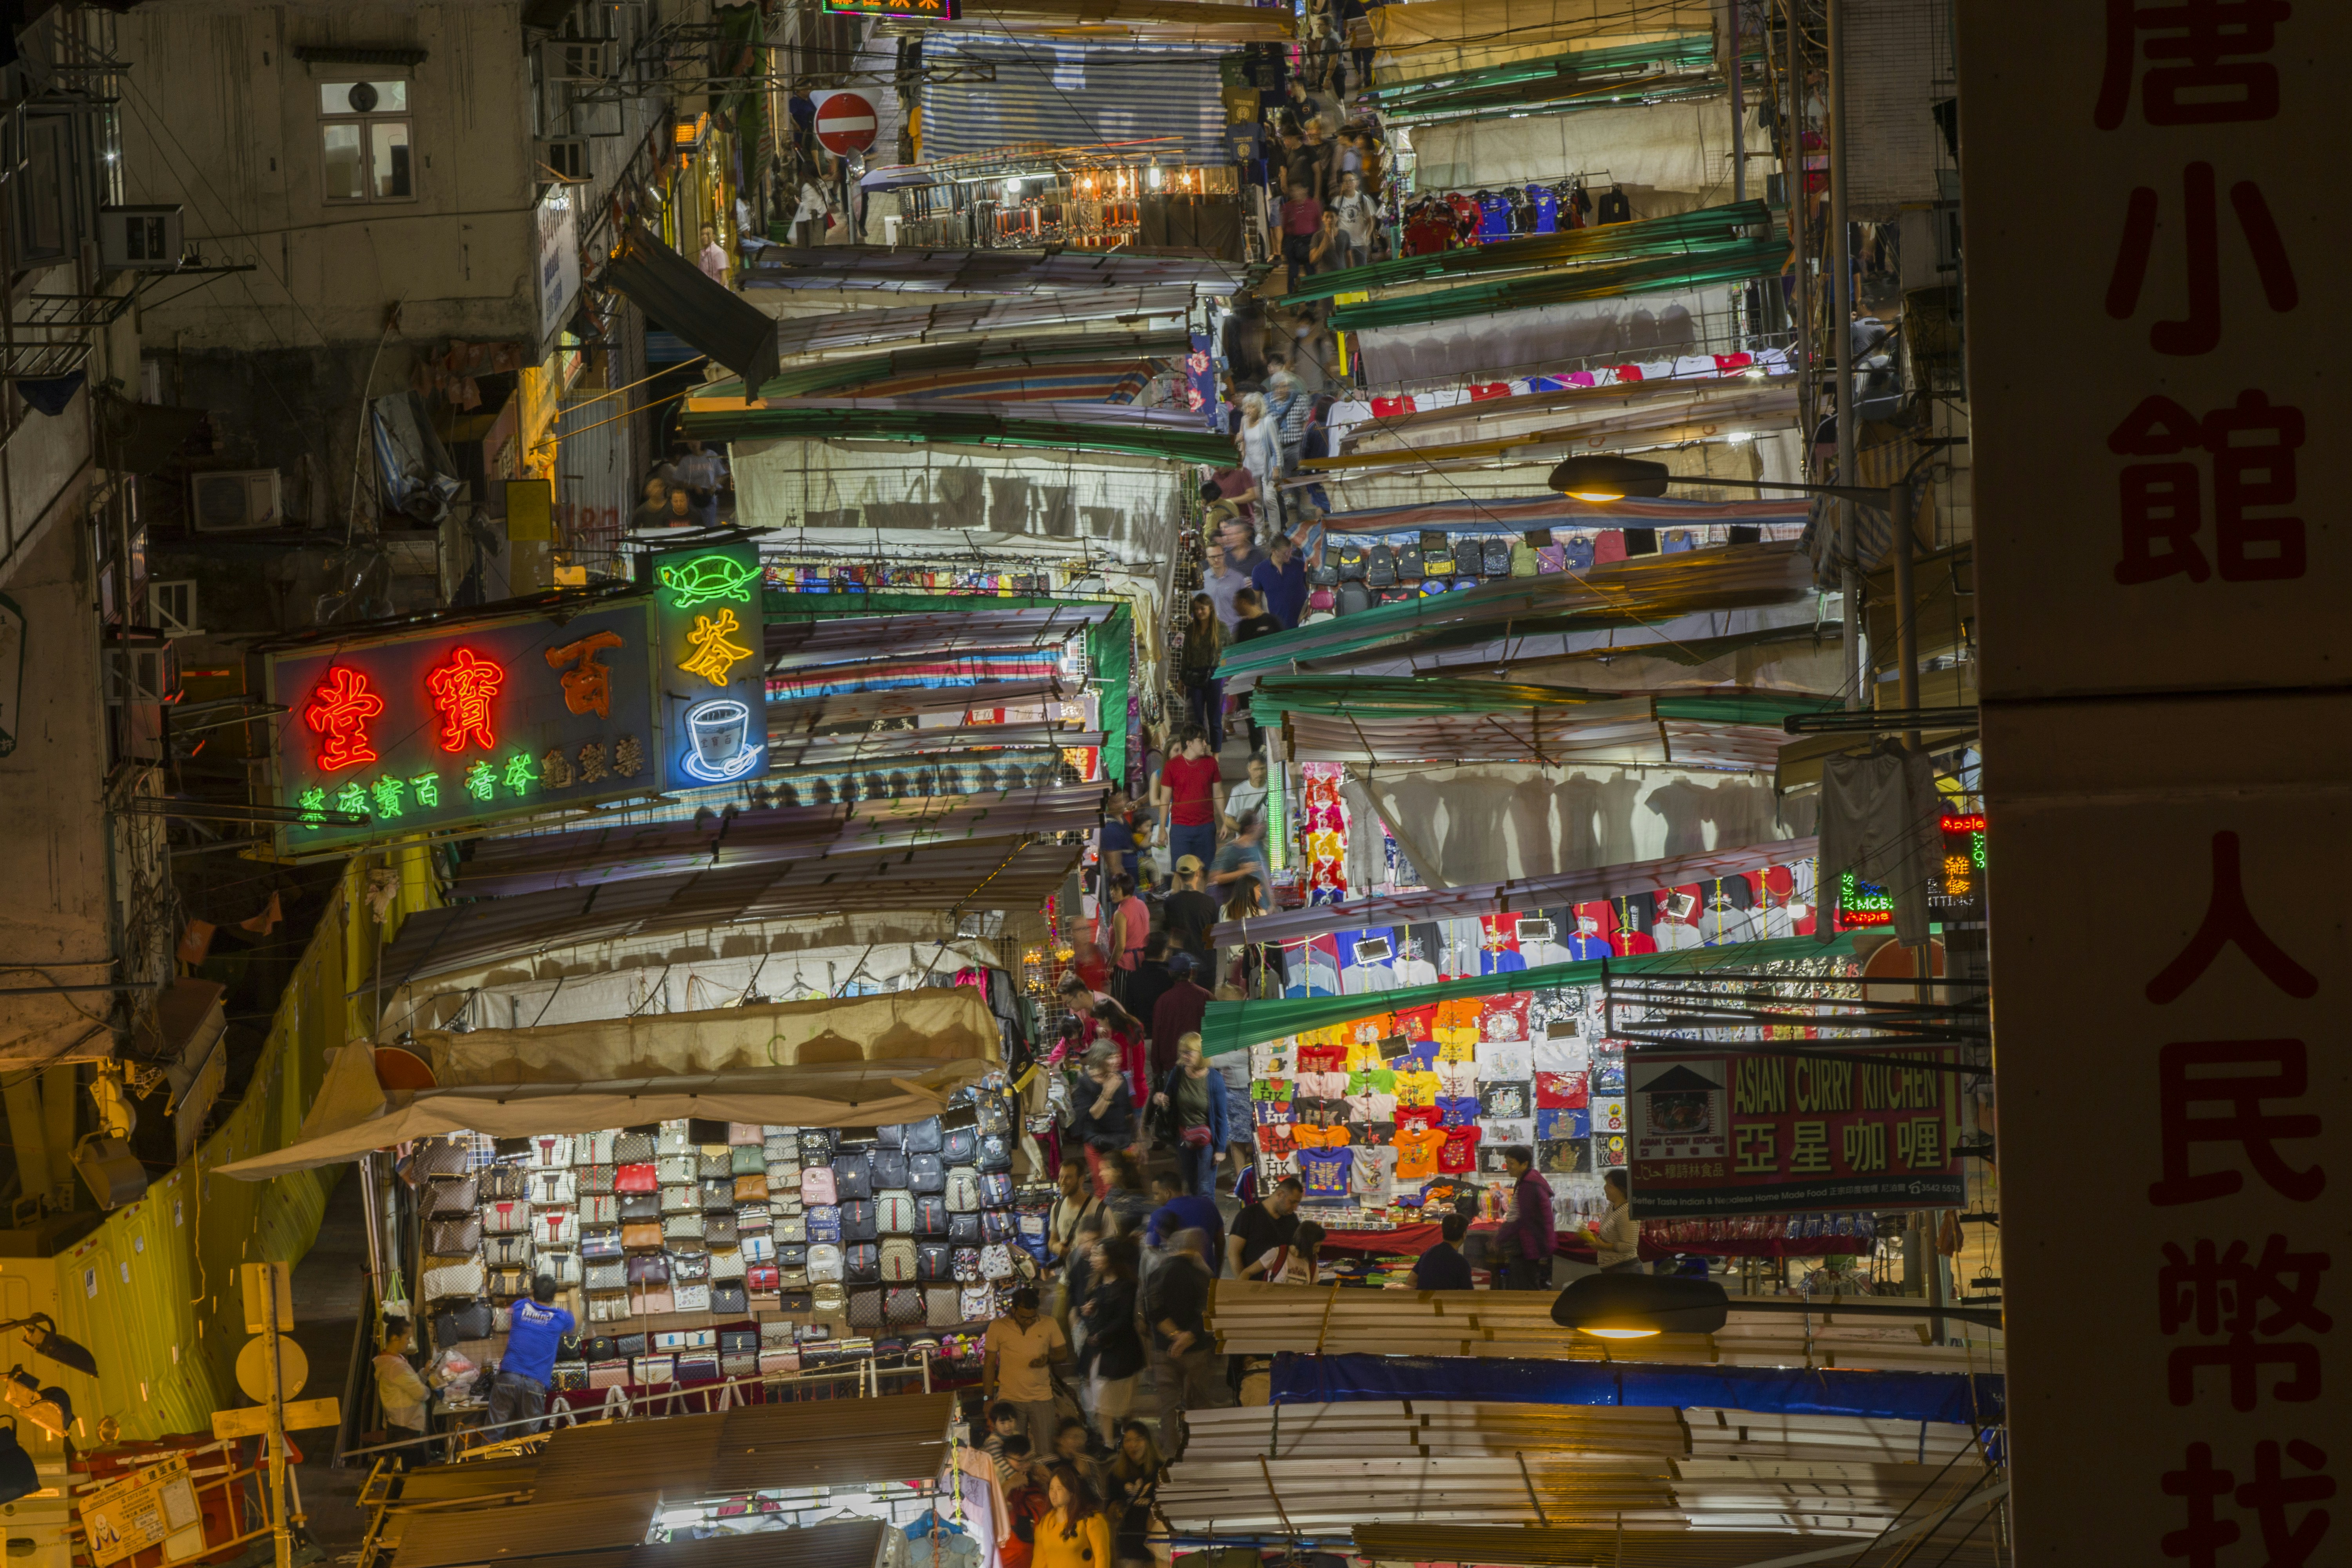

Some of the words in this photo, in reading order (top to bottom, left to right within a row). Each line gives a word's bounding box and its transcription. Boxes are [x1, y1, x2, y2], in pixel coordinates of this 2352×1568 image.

[2094, 0, 2307, 584] 唐小館
[307, 630, 625, 772] 百寶堂
[1943, 818, 1985, 829] Apple
[1945, 856, 1970, 895] 維修
[1261, 1081, 1269, 1090] I
[1734, 1057, 1786, 1114] ASIAN
[1795, 1057, 1853, 1112] CURRY
[1862, 1051, 1938, 1110] KITCHEN
[1261, 1091, 1283, 1101] HK
[1265, 1112, 1290, 1123] HK
[1267, 1125, 1276, 1138] I
[1268, 1138, 1293, 1152] HK
[1639, 1138, 1662, 1147] ASIAN
[1664, 1137, 1690, 1145] CURRY
[1693, 1136, 1724, 1144] KITCHEN
[1733, 1116, 1942, 1173] 亞星咖喱
[1266, 1151, 1274, 1161] I
[1266, 1162, 1290, 1175] HK
[1309, 1161, 1342, 1186] HK
[1632, 1196, 1655, 1205] Better
[1657, 1198, 1678, 1206] Taste
[1680, 1197, 1705, 1205] Indian
[1715, 1195, 1753, 1206] Nepalese
[1755, 1194, 1779, 1202] Home
[1782, 1191, 1804, 1200] Made
[1807, 1188, 1828, 1198] Food
[1921, 1183, 1940, 1192] 3542
[1942, 1184, 1961, 1193] 5575
[2146, 830, 2337, 1568] 人民幣找
[93, 1485, 119, 1500] ARCHITECTURAL
[105, 1488, 127, 1502] DEPARTMENT
